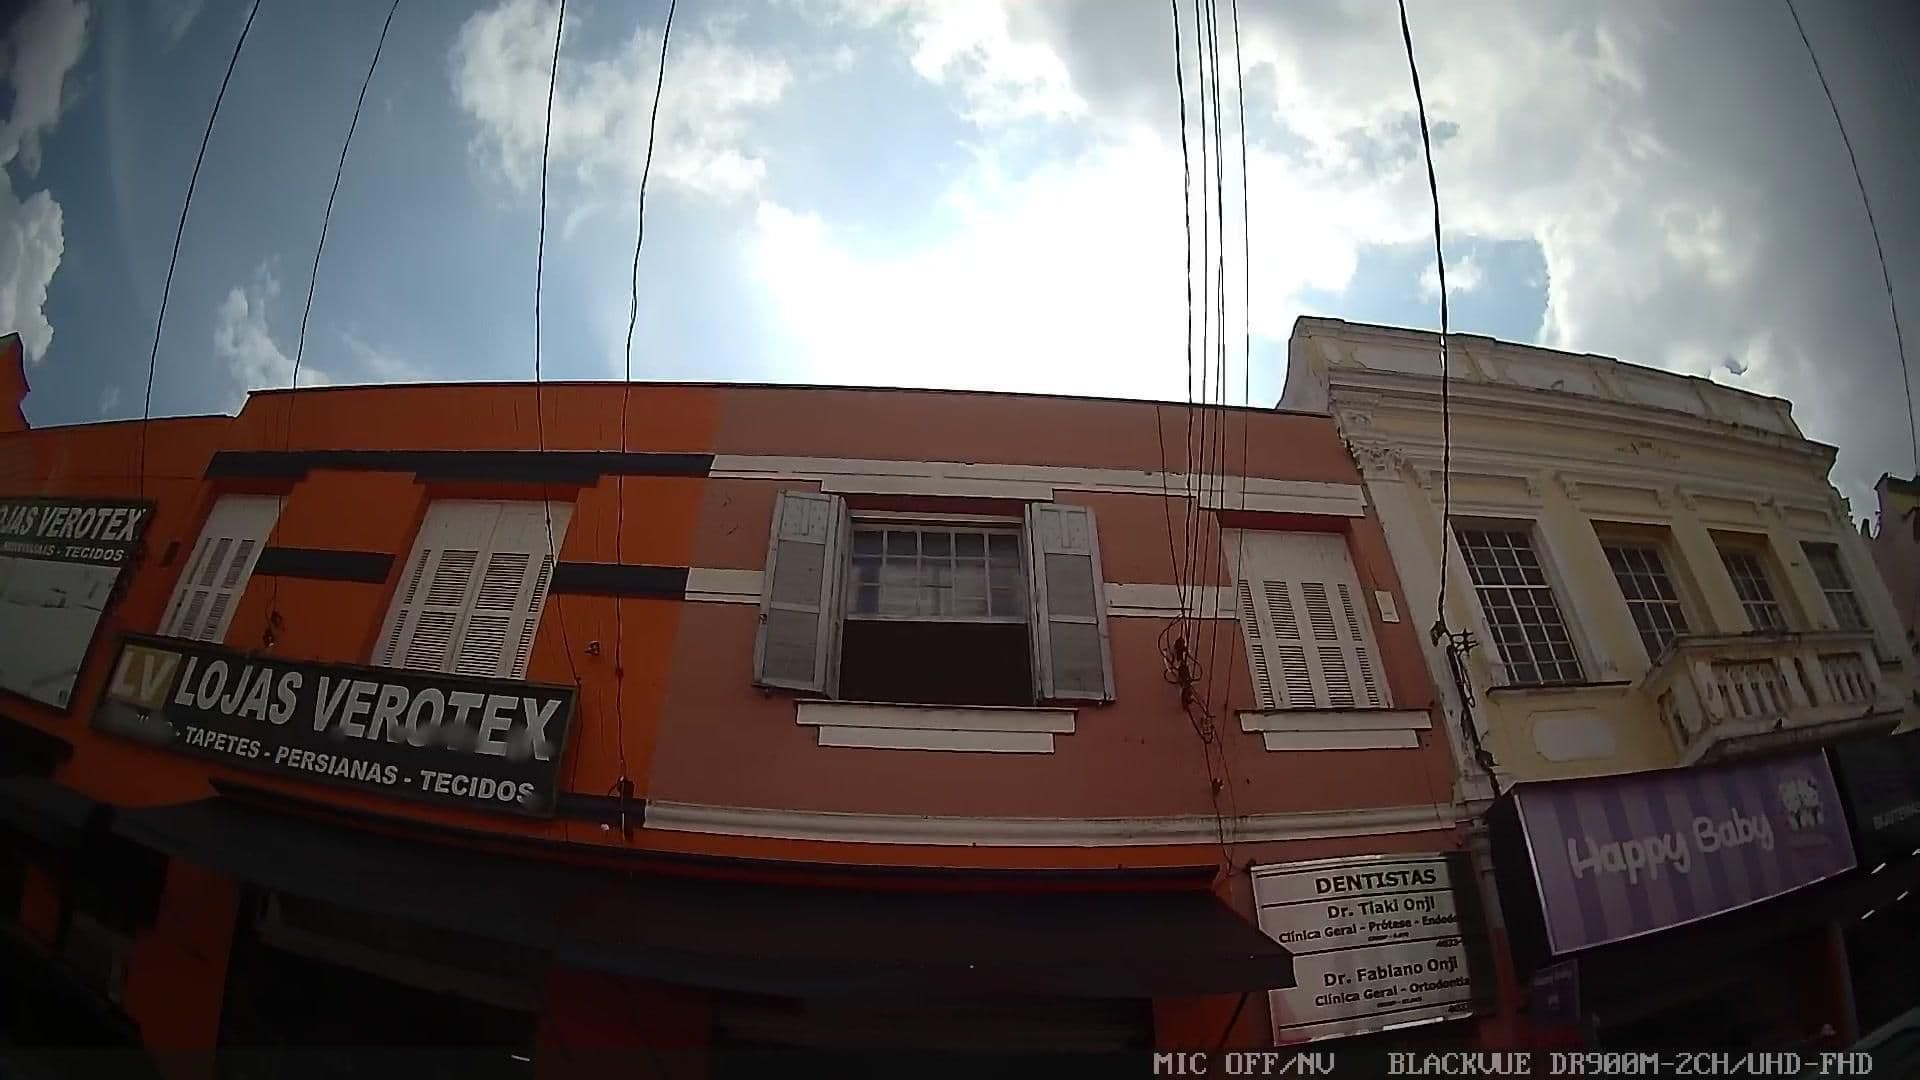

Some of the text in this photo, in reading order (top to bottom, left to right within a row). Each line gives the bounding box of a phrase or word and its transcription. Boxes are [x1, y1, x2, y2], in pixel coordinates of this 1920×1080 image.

[36, 506, 146, 541] VEROTEX
[65, 545, 125, 562] TECIDOS
[174, 656, 303, 725] LOJAS
[313, 676, 563, 761] VEROTEX
[185, 725, 261, 759] TAPETES
[275, 745, 398, 785] PERSIANAS
[420, 769, 535, 804] TECIDOS
[1568, 808, 1775, 884] Happy Baby
[1315, 868, 1437, 895] DENTISTAS
[1327, 906, 1353, 919] Dr.
[1278, 929, 1322, 944] Clínica
[1324, 923, 1357, 938] Geral
[1368, 917, 1412, 933] Prótese
[1324, 973, 1352, 987] Dr.
[1358, 964, 1423, 983] Fabiano
[1315, 992, 1360, 1007] Clínica
[1364, 986, 1398, 1001] Geral
